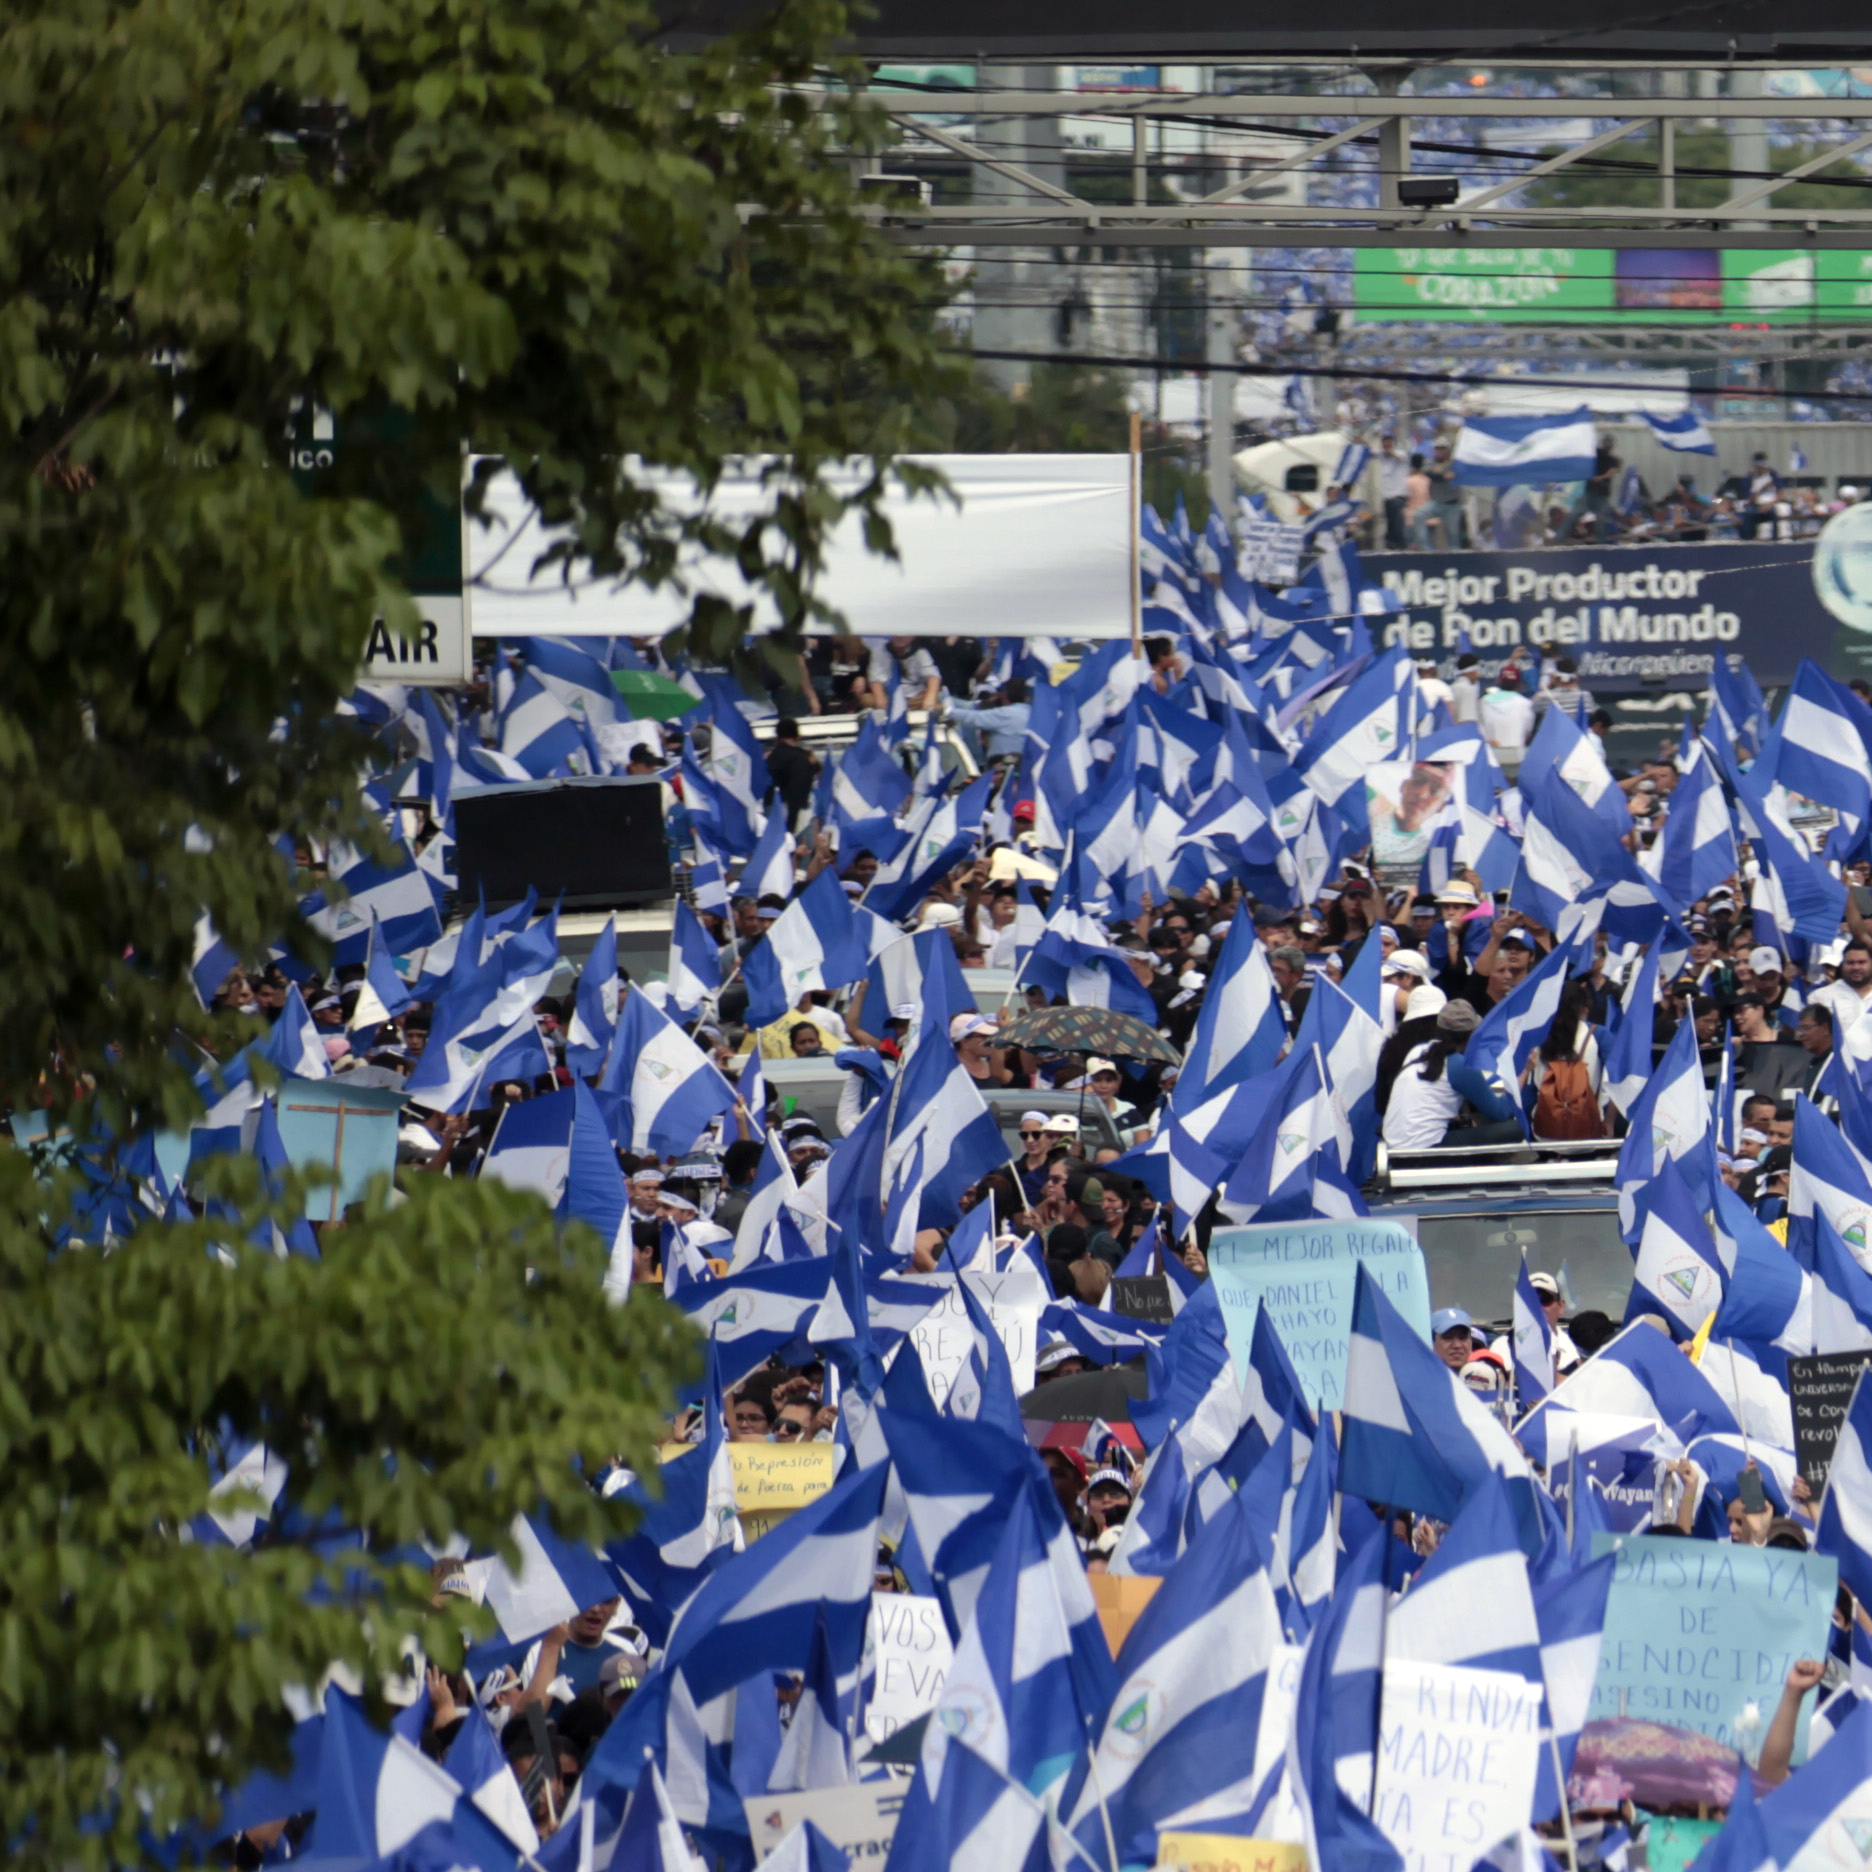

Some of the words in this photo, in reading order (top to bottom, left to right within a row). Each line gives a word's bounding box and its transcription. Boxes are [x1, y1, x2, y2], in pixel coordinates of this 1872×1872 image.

[1383, 567, 1500, 611] Mejor
[1507, 563, 1706, 602] Productor
[1384, 614, 1435, 648] de
[1527, 606, 1591, 645] del
[1600, 603, 1741, 643] Mundo
[1263, 1233, 1334, 1261] MEJOR
[1347, 1231, 1420, 1257] REGALO
[1222, 1287, 1254, 1309] QUE
[1265, 1279, 1337, 1308] DANIEL
[1272, 1307, 1337, 1331] HAYO
[1765, 1554, 1810, 1607] YA
[878, 1603, 937, 1653] VOS
[1680, 1606, 1719, 1635] DE
[1418, 1675, 1535, 1735] RINDA
[1441, 1794, 1487, 1845] ES
